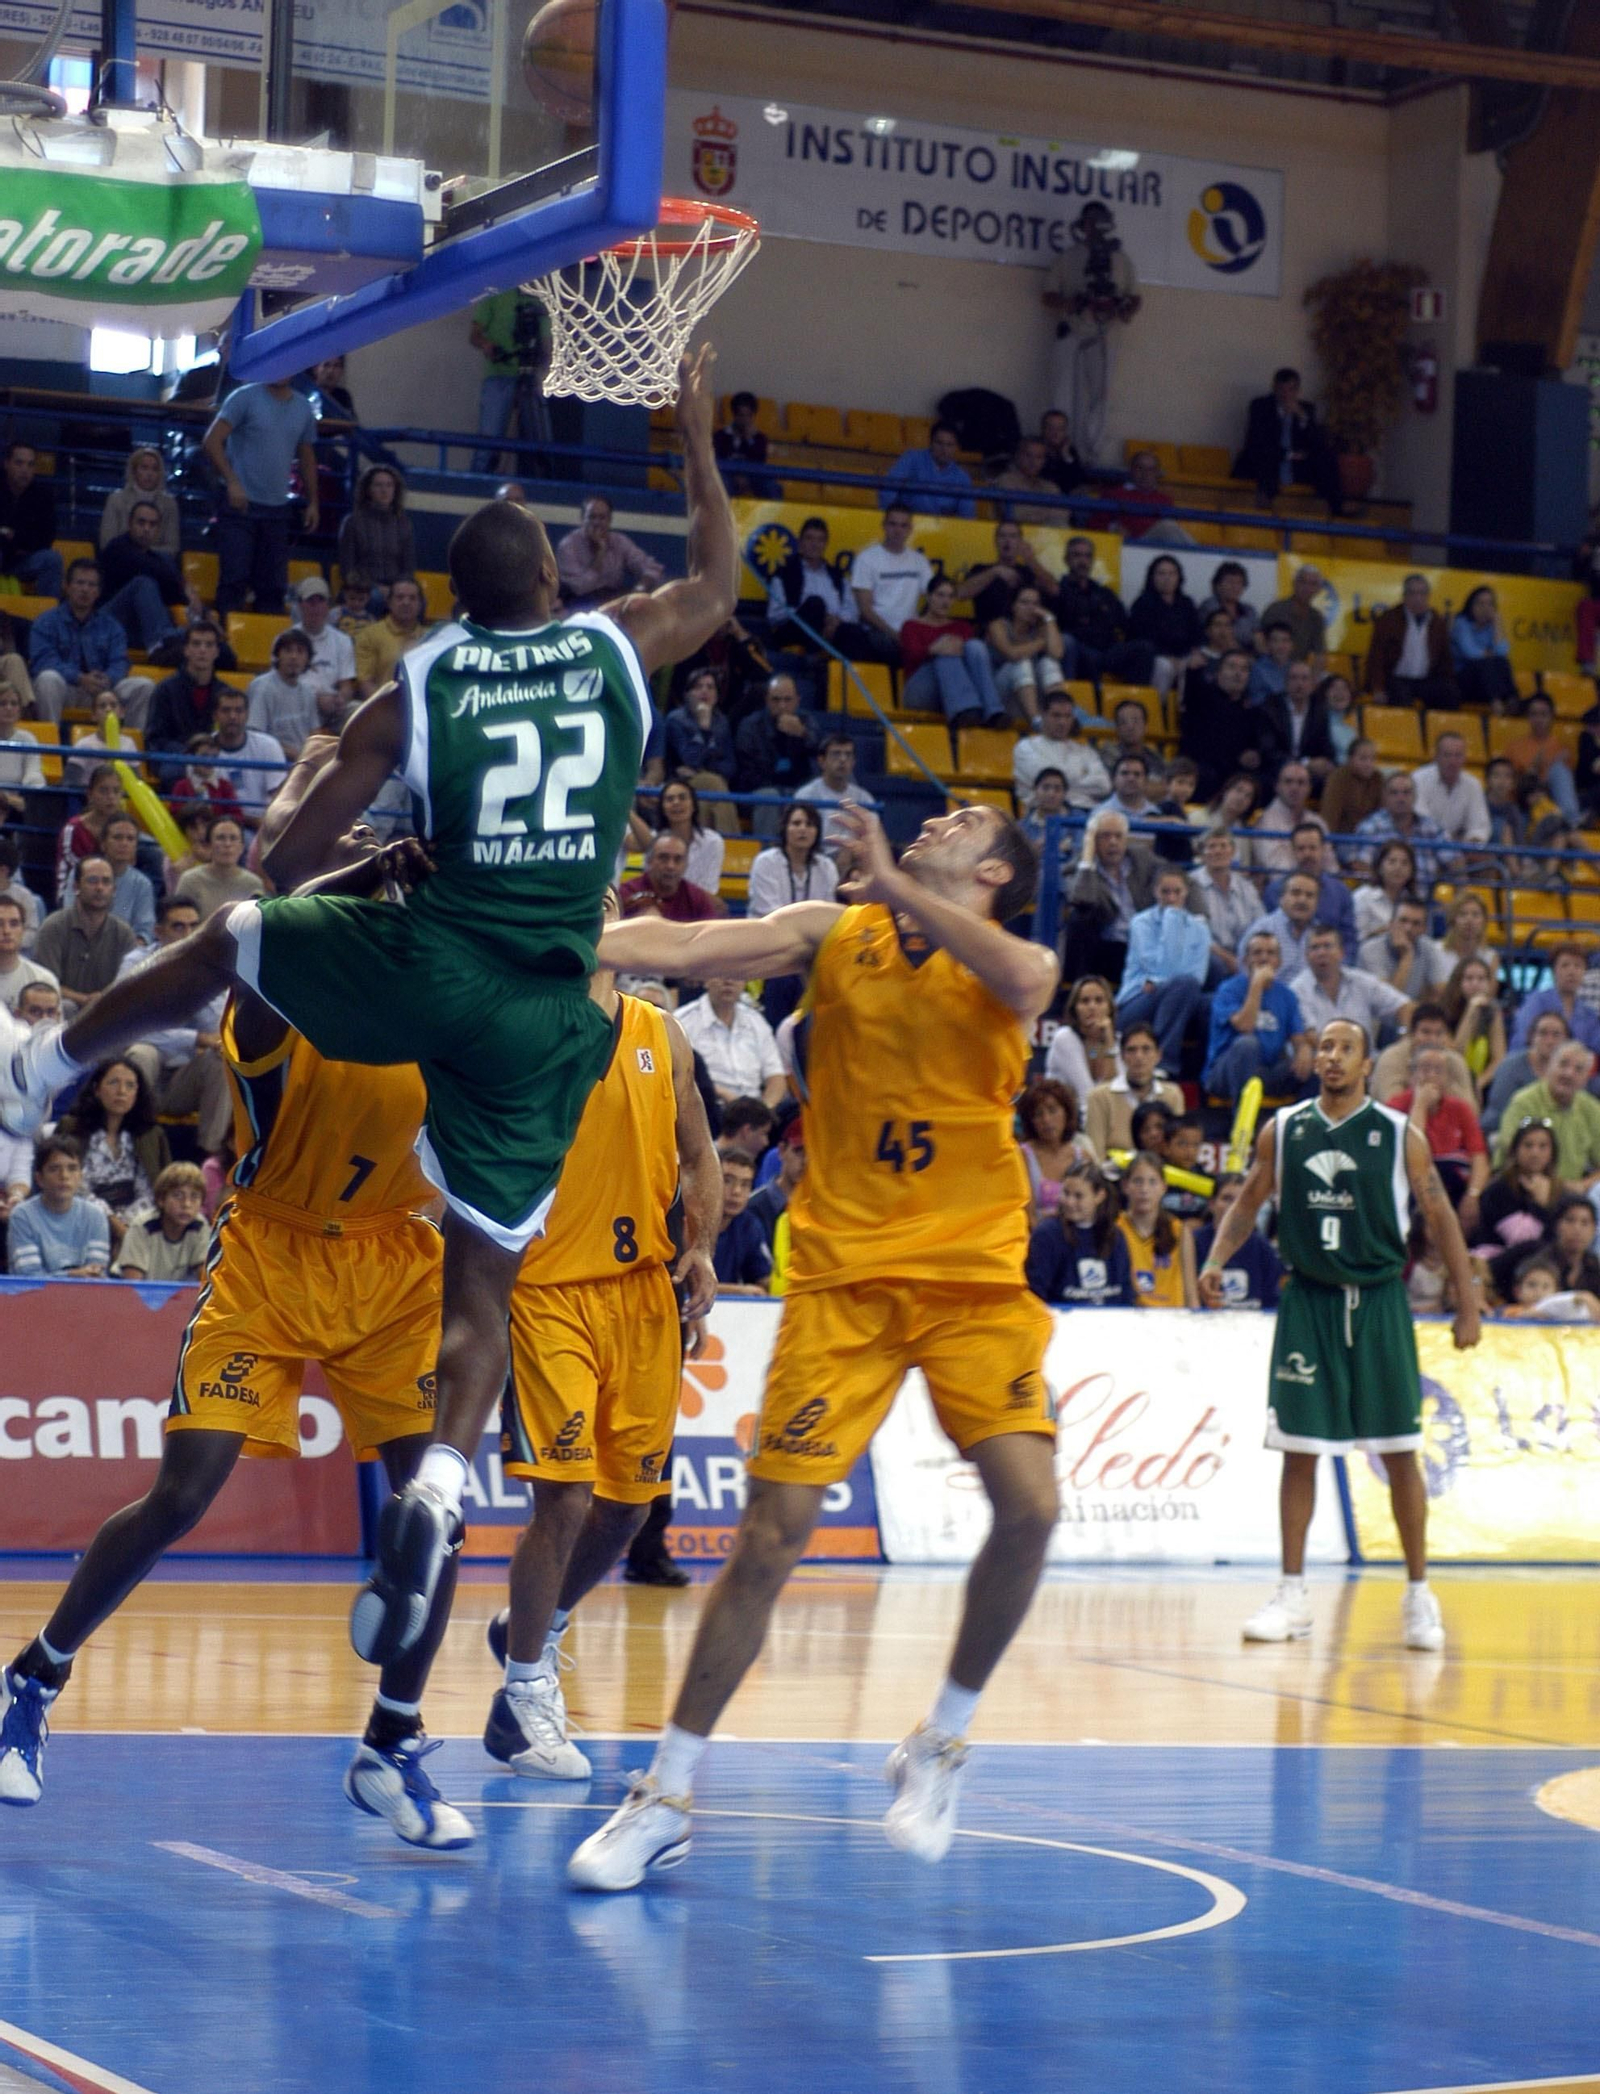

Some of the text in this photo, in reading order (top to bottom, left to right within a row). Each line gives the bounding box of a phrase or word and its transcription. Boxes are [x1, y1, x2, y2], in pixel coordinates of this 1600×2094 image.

[786, 119, 1162, 207] INSTITUTO INSULAR
[857, 206, 888, 234] DE
[476, 710, 606, 837] 22
[472, 832, 597, 866] MÁLAGA
[876, 1119, 936, 1172] 45
[339, 1154, 377, 1202] 7
[612, 1216, 639, 1263] 8
[1320, 1215, 1341, 1251] 9
[199, 1381, 261, 1409] FADESA
[0, 1395, 343, 1460] camo
